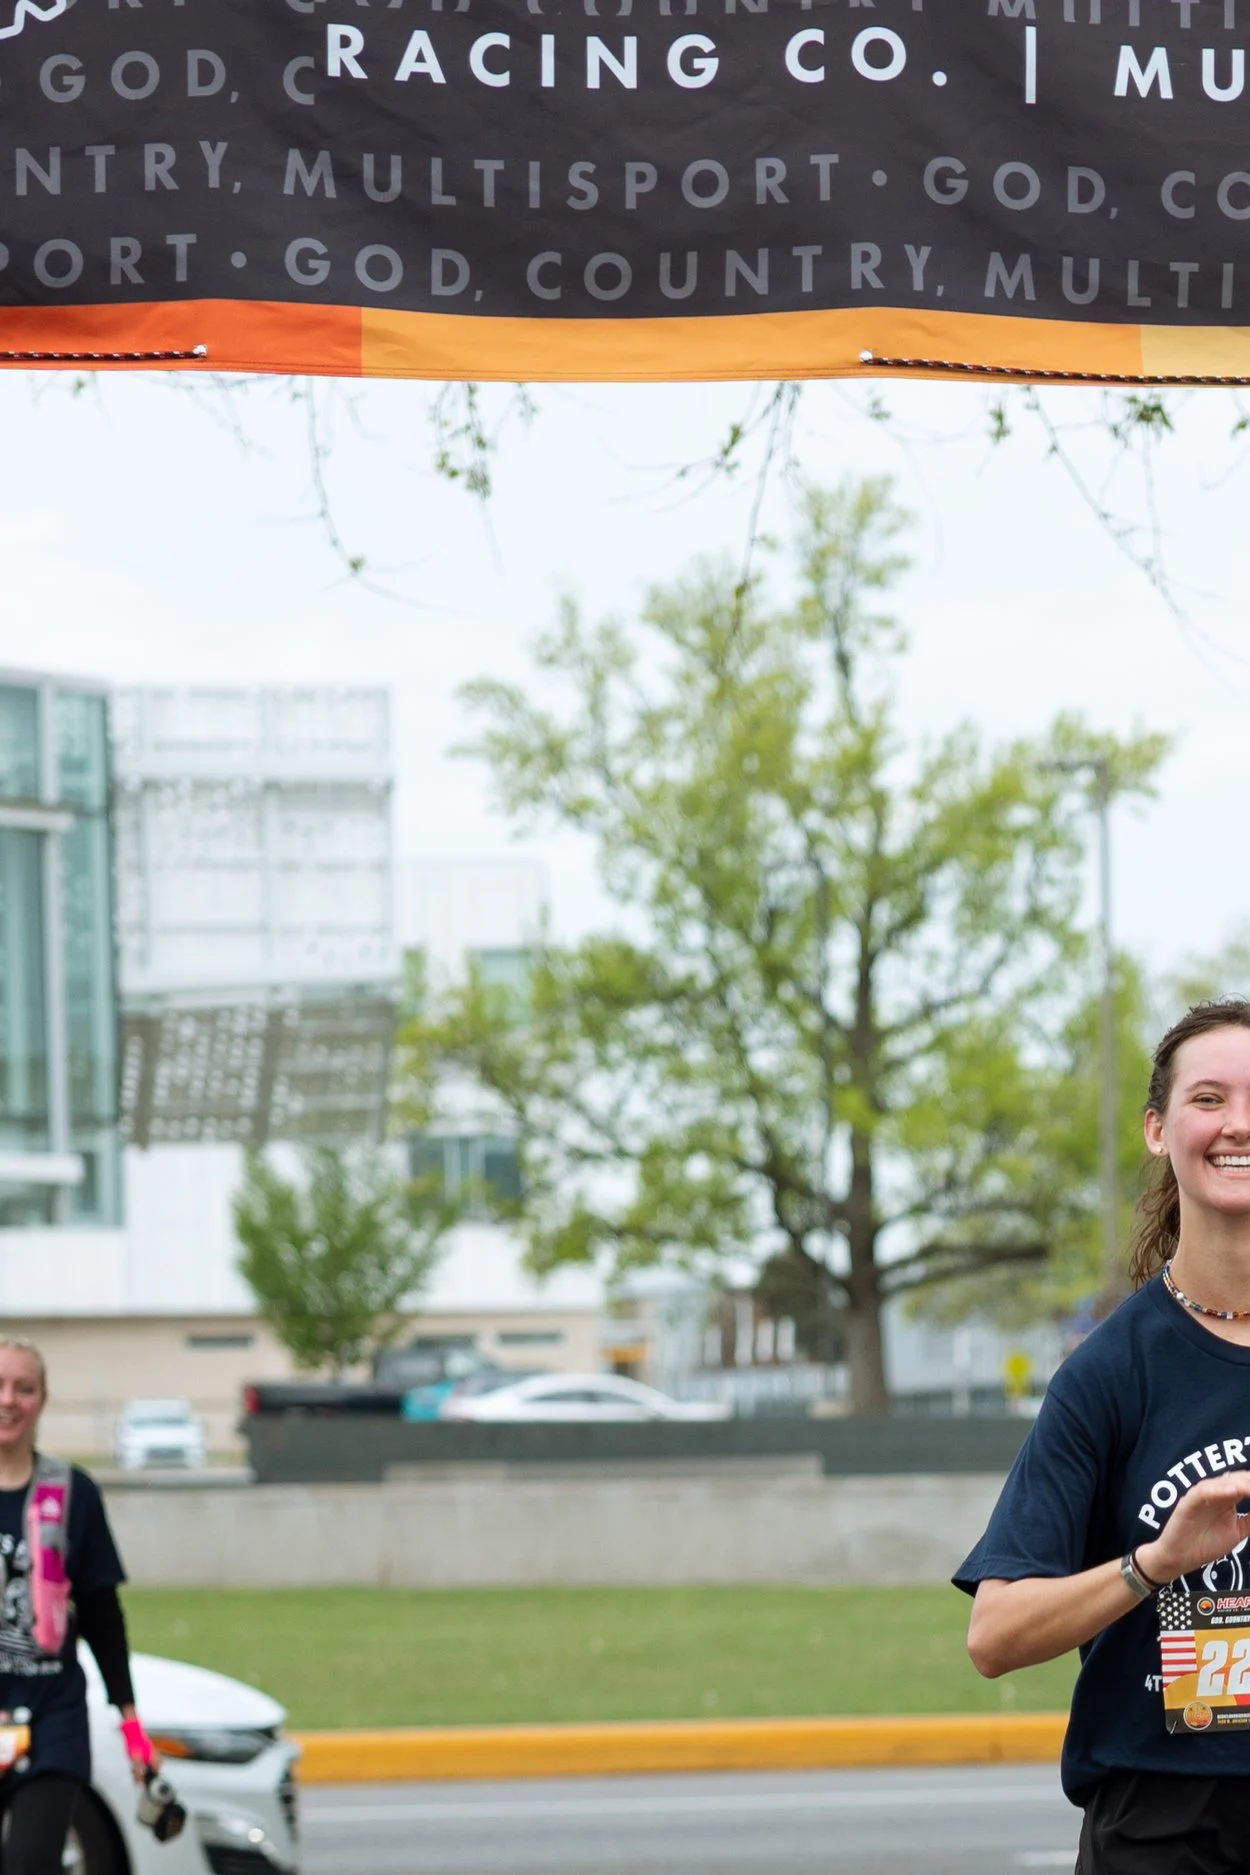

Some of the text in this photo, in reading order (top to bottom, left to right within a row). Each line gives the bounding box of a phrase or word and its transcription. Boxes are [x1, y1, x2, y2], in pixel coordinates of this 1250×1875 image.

[40, 49, 239, 104] GOD,
[327, 24, 720, 89] RACING
[784, 27, 947, 87] CO.
[15, 141, 242, 195] NTRY,
[283, 150, 839, 210] MULTISPORT
[924, 157, 1117, 219] GOD,
[284, 237, 482, 302] GOD,
[527, 243, 944, 300] COUNTRY,
